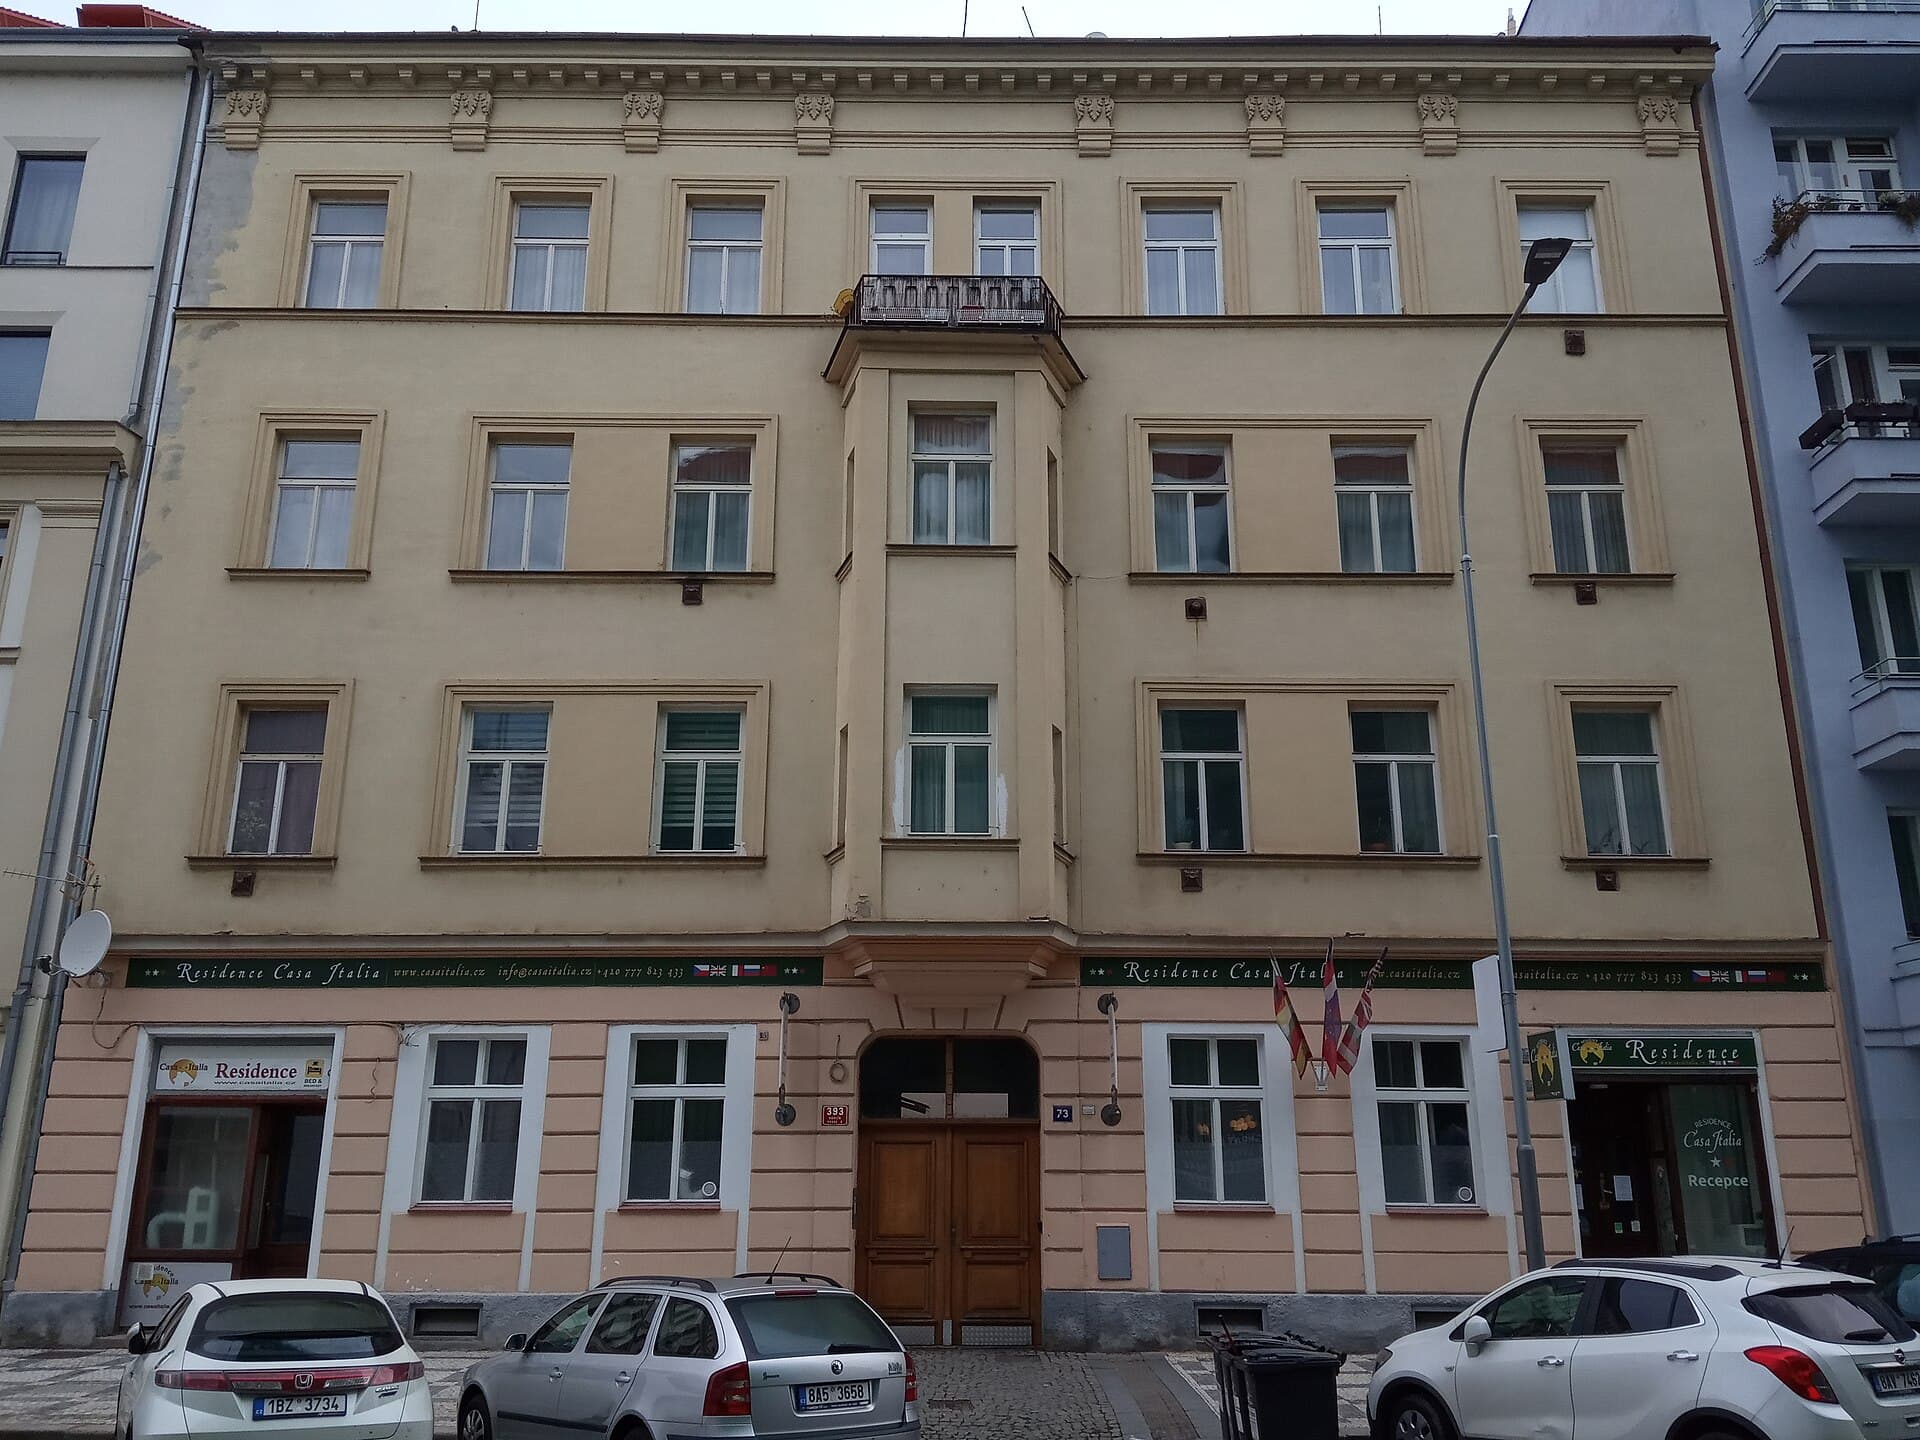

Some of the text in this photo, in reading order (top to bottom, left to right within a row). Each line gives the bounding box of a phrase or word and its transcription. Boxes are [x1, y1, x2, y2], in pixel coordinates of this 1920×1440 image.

[177, 963, 381, 985] Residence Casa Italia
[394, 963, 487, 977] www.casaitalia.cz
[498, 963, 592, 981] info@casaitalia.cz
[1123, 961, 1344, 985] Residence Casa Itala
[1360, 966, 1460, 979] ww.casaitalia.cz
[1625, 1040, 1739, 1065] Residence
[215, 1062, 298, 1080] Residence
[826, 1107, 844, 1116] 393
[1056, 1108, 1069, 1119] 73
[1694, 1119, 1732, 1130] RESIDENCE
[1683, 1129, 1742, 1153] Casa Italia
[1687, 1174, 1749, 1190] Recepce
[808, 1384, 865, 1403] 8A5 3658
[268, 1397, 339, 1413] 1BZ 3734
